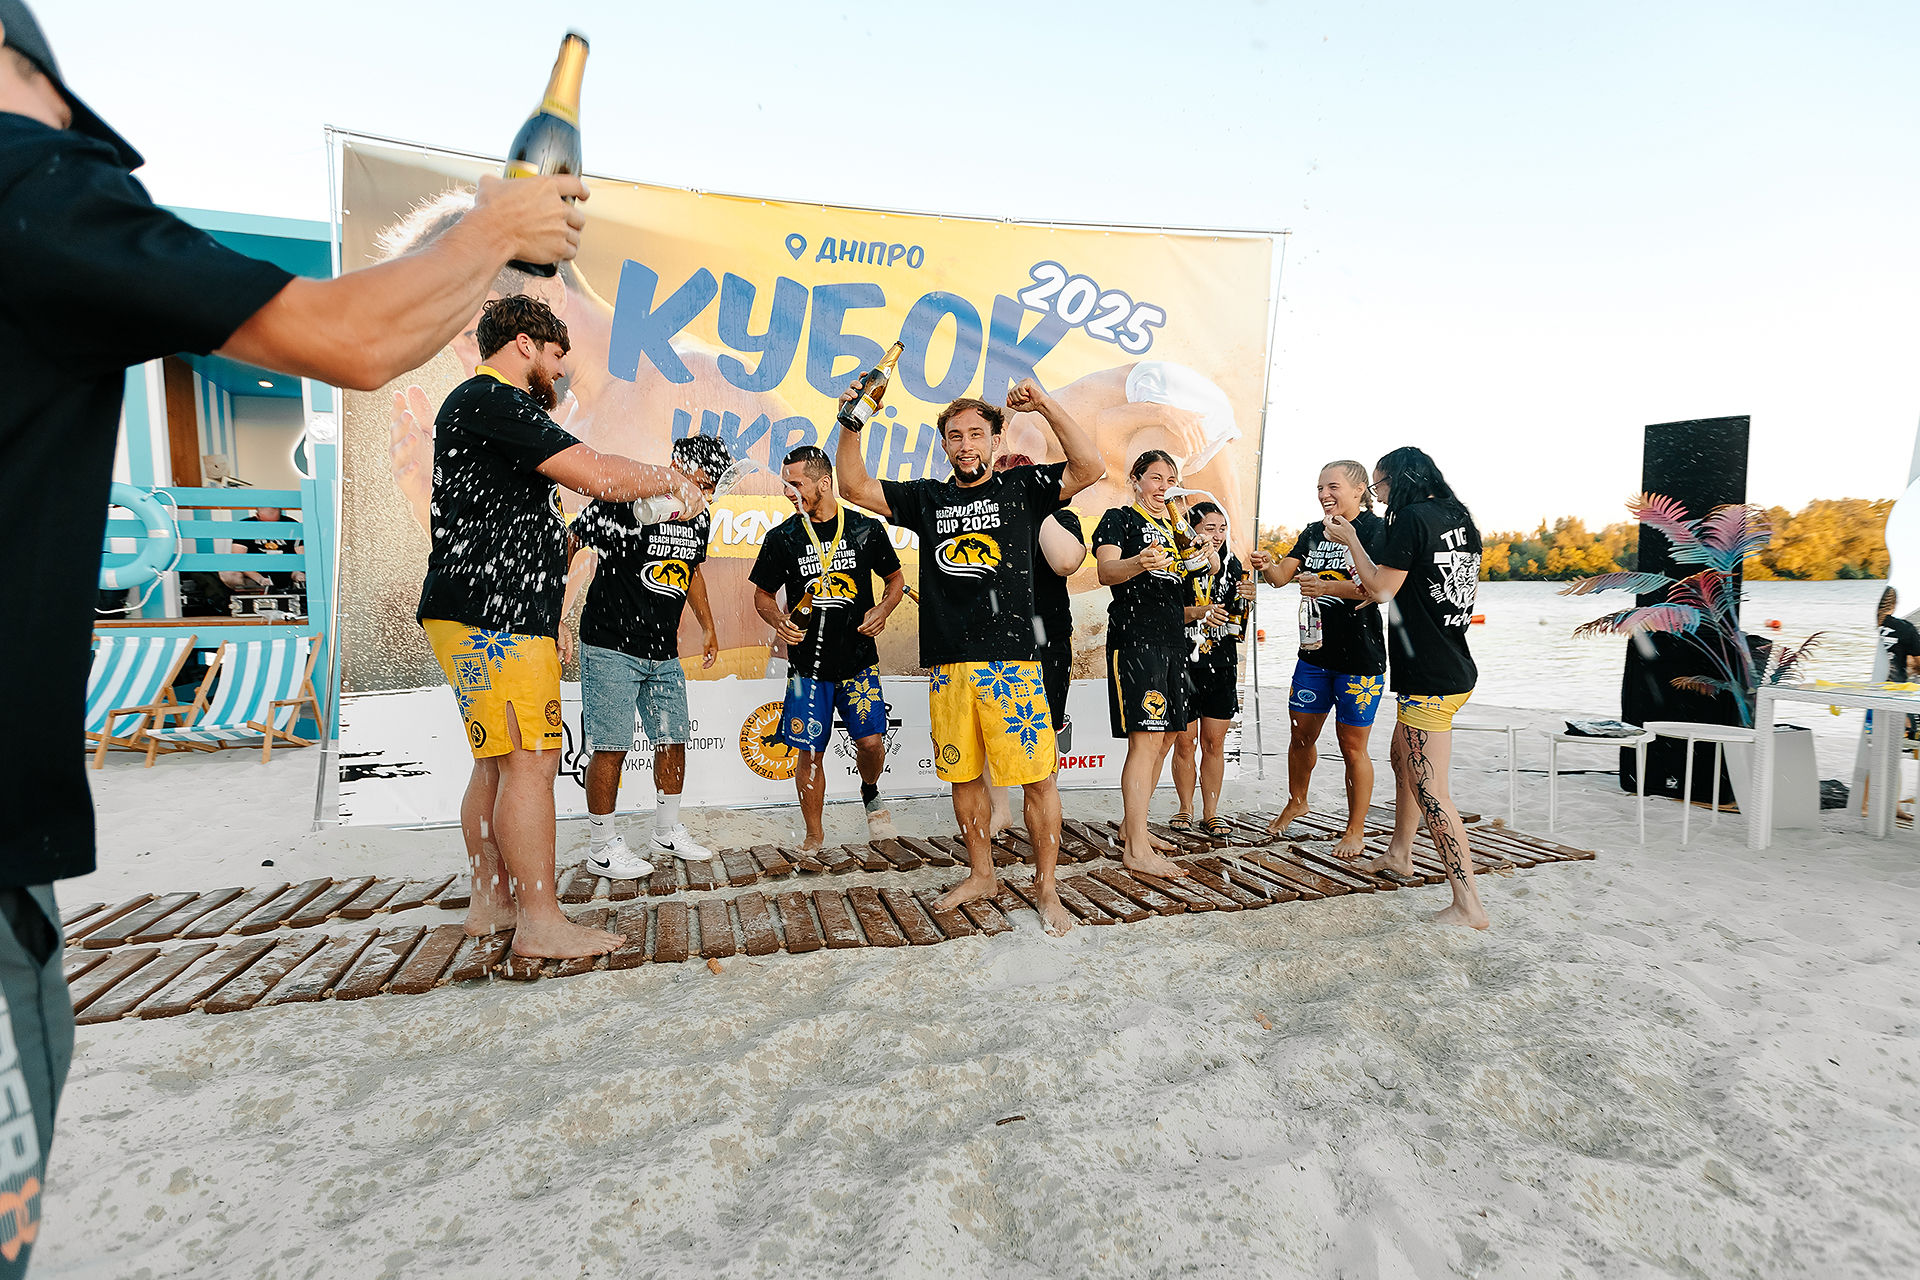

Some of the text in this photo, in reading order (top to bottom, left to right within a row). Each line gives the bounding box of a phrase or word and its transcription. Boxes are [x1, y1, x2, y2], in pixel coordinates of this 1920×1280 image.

[815, 236, 925, 269] ДНІПРО
[1017, 260, 1166, 355] 2025
[607, 258, 1073, 408] КУБОК
[659, 522, 694, 539] DNIPRO
[936, 513, 1001, 534] CUP 2025
[649, 535, 698, 548] BEACH WRESTLING
[1143, 533, 1167, 545] CUP
[1440, 526, 1468, 550] TIG
[647, 544, 697, 560] CUP 2025
[798, 554, 820, 566] BEACH
[800, 557, 857, 576] CUP 2025
[1305, 557, 1347, 570] CUP 202
[686, 737, 726, 751] СПОРТУ
[624, 756, 654, 771] УКРА
[1059, 754, 1106, 769] АРКЕТ
